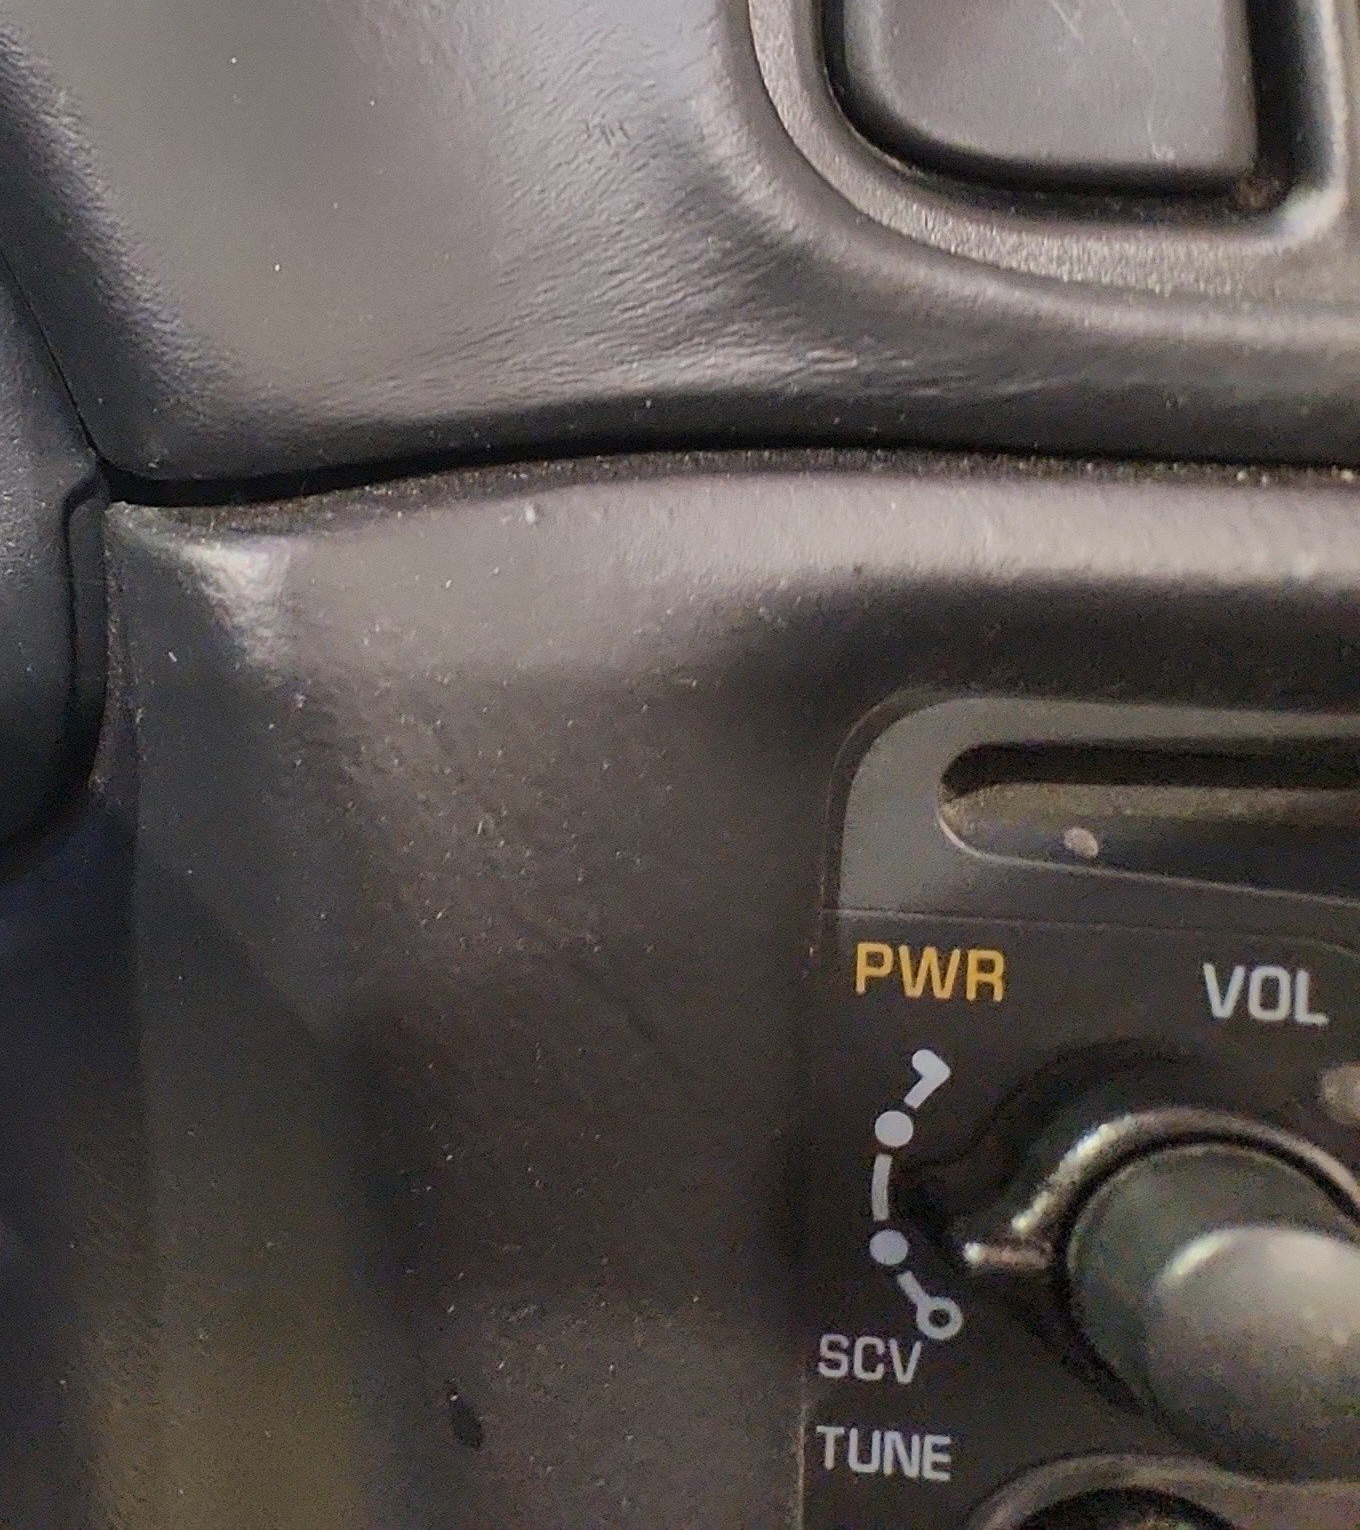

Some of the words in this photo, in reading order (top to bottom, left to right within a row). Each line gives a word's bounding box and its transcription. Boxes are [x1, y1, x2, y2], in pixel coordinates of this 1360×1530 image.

[854, 940, 1007, 1003] PWR
[1202, 962, 1329, 1027] VOL
[816, 1332, 924, 1386] SCV
[814, 1424, 953, 1483] TUNE
